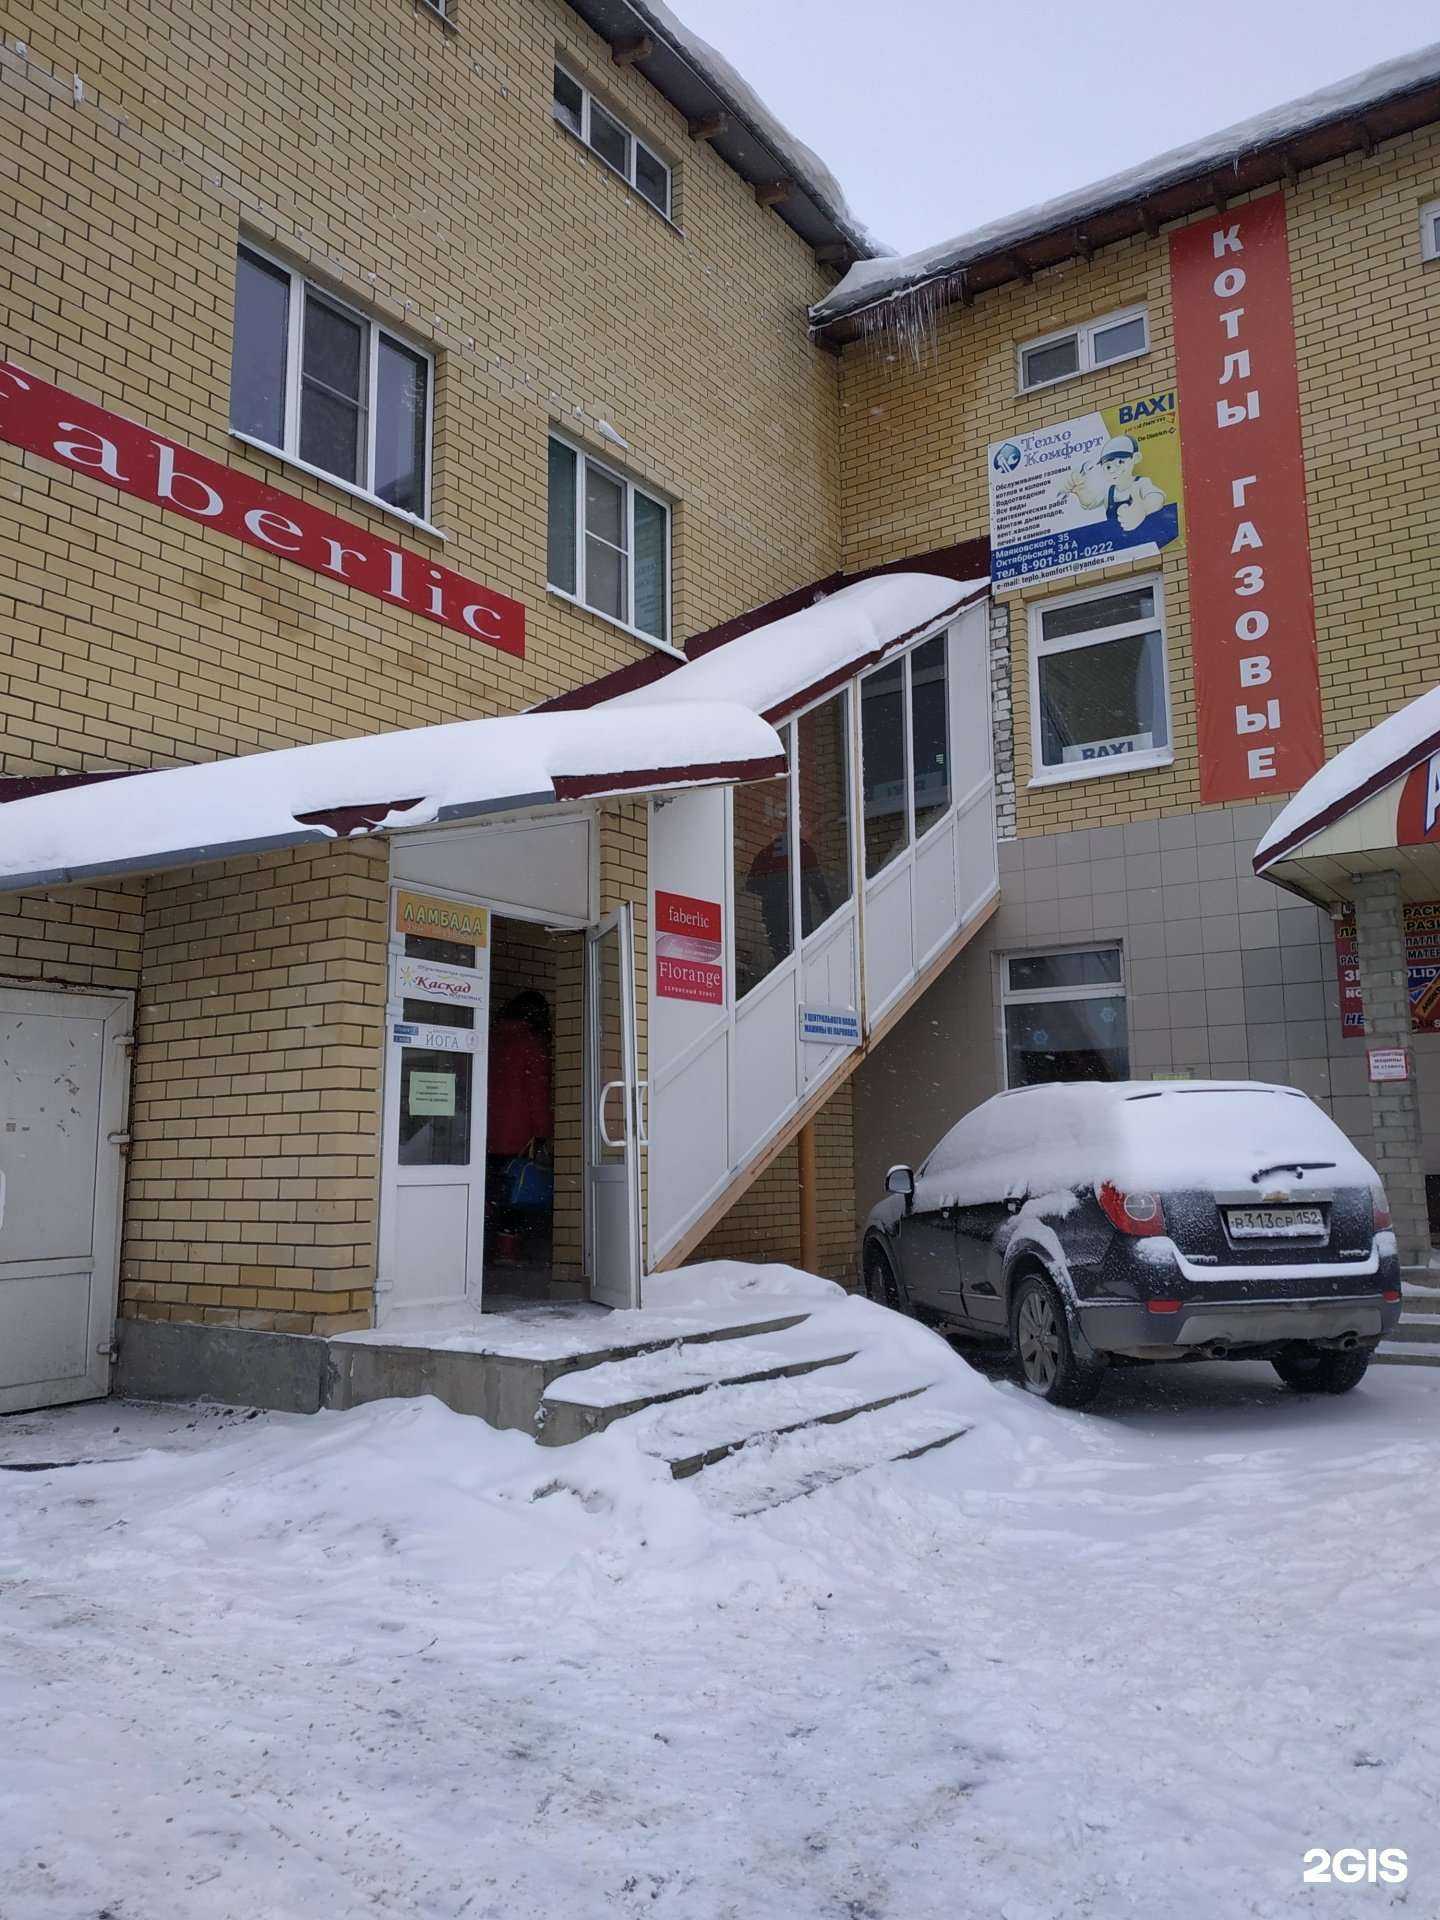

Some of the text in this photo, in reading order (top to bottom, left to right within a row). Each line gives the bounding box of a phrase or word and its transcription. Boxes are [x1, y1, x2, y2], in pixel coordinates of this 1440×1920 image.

[1212, 223, 1261, 429] КОТЛЫ
[1119, 392, 1175, 424] BAXI
[1021, 430, 1072, 452] Тепло
[1024, 436, 1104, 467] Комфорт
[995, 489, 1018, 500] котлов
[1025, 480, 1051, 492] колонок
[996, 465, 1071, 491] Обслуживание газовых
[995, 489, 1046, 507] Водоотведение
[1009, 503, 1027, 512] виды
[996, 499, 1067, 523] сантехнических работ
[996, 520, 1022, 531] Монтаж
[995, 532, 1070, 559] Маяковского, 35
[995, 548, 1056, 568] Октябрьская,
[1058, 542, 1070, 552] 34
[996, 541, 1114, 580] тел. 8-901-801-0222
[1021, 555, 1115, 583] teplo.komfort1@yandex.ru
[1230, 475, 1281, 780] ГАЗОВЫЕ
[1081, 741, 1134, 760] BAXI
[404, 902, 482, 936] ЛАМБАДА
[668, 905, 711, 929] faberlic
[415, 975, 472, 994] Каскад
[659, 961, 721, 989] Florange
[426, 1031, 459, 1048] ЙОГА
[1296, 1211, 1319, 1225] 152
